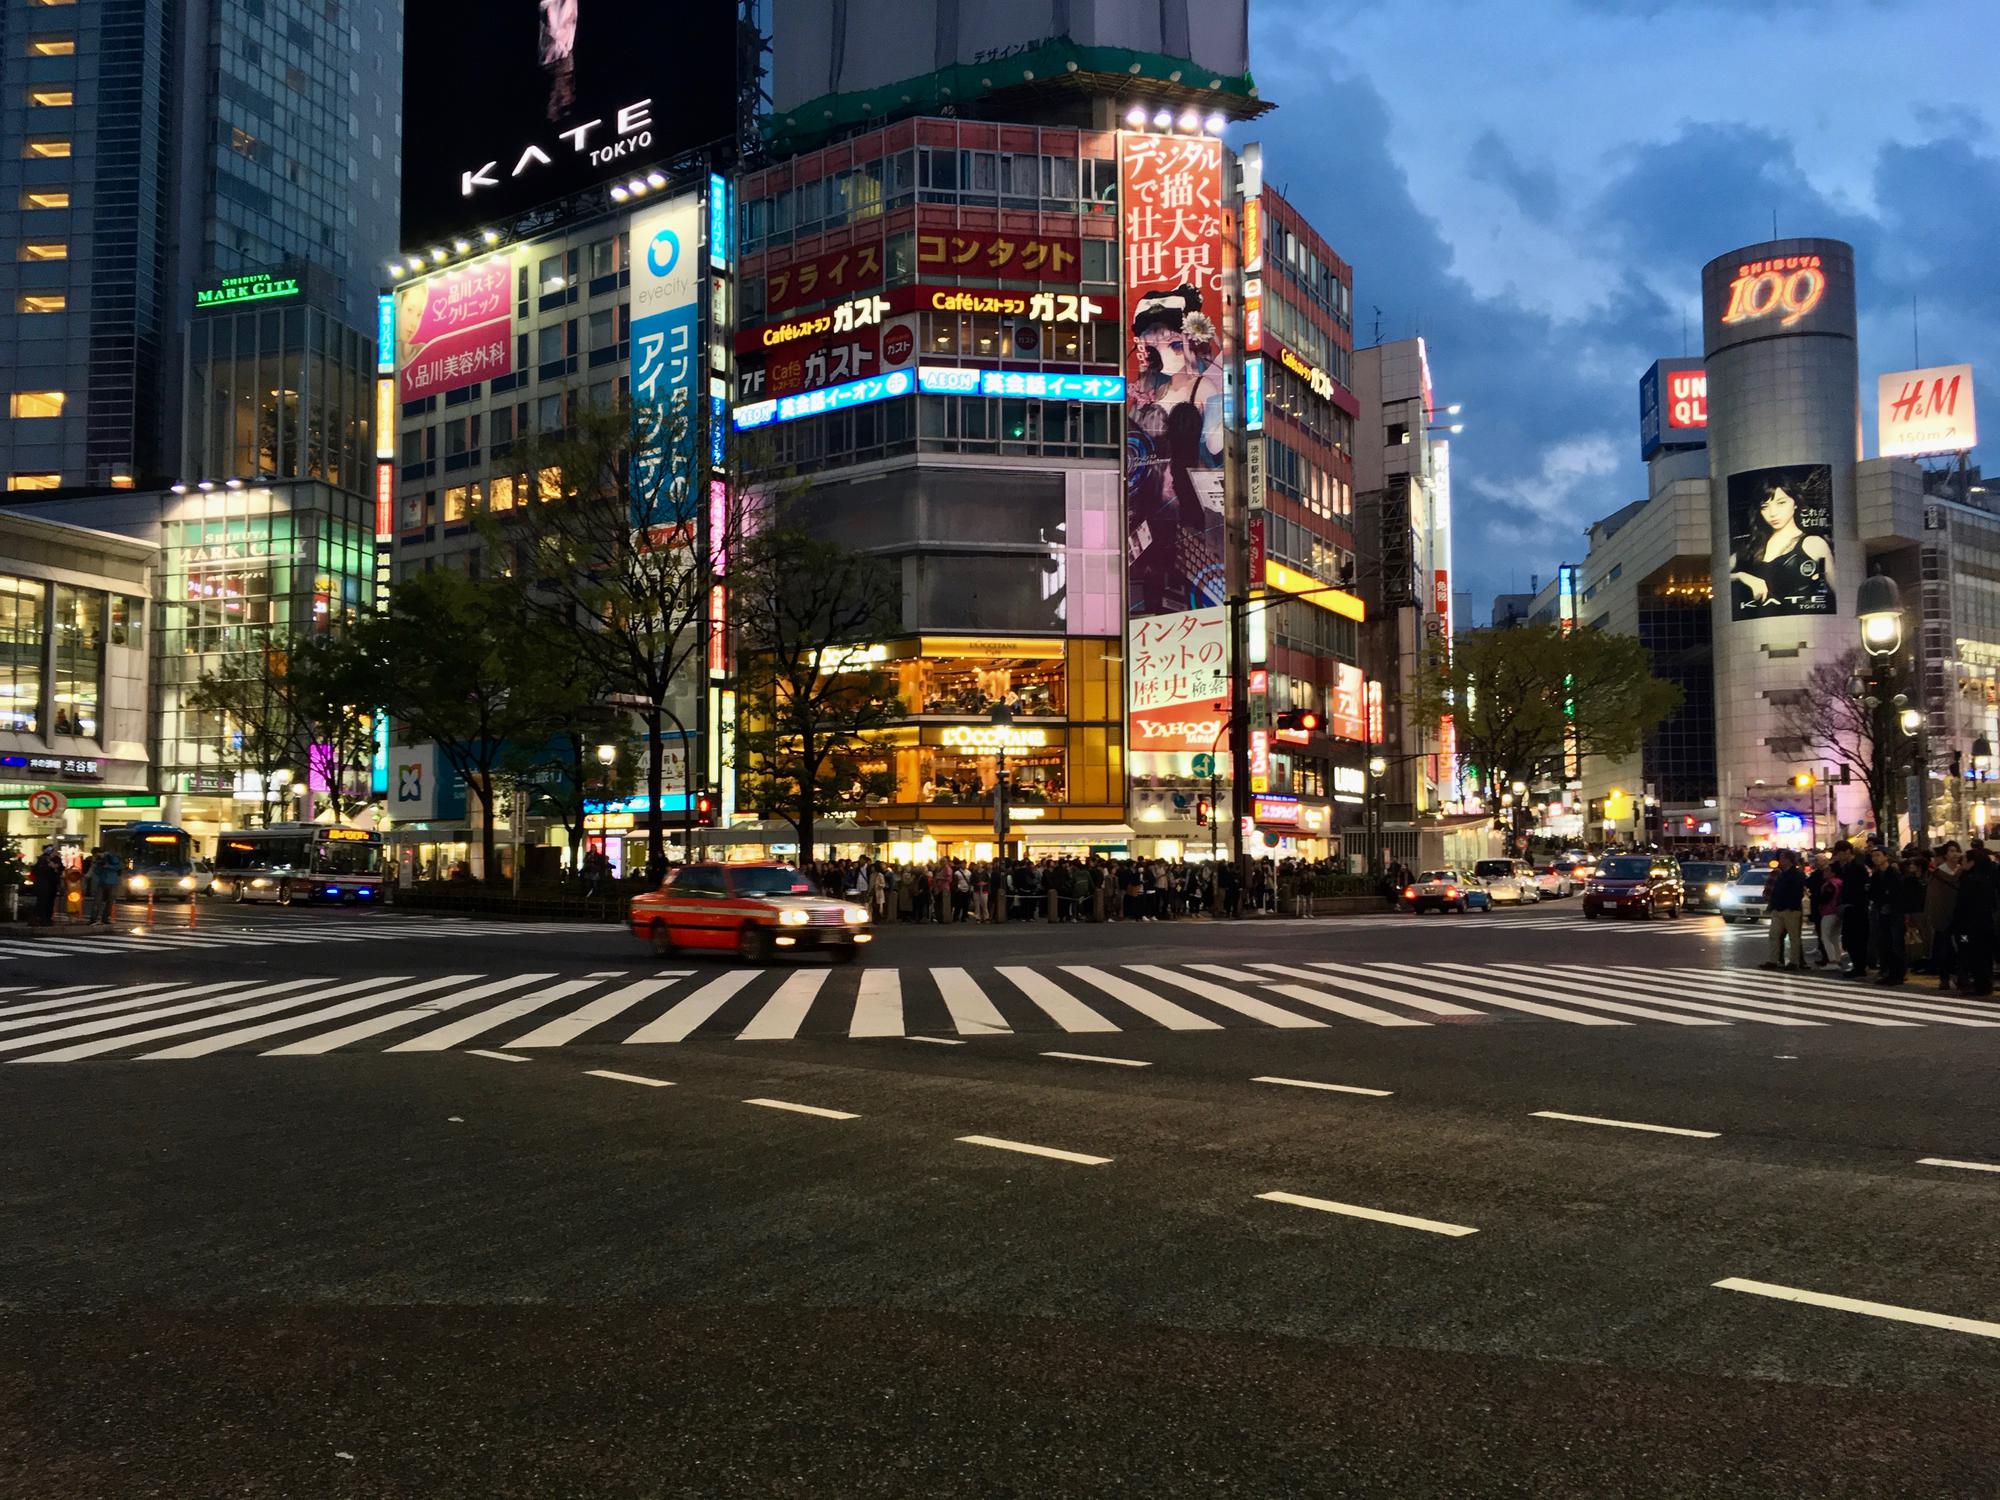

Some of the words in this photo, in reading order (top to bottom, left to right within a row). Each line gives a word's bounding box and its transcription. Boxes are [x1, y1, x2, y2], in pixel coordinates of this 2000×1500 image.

[462, 99, 651, 195] KATE
[590, 131, 651, 166] TOKYO
[1125, 137, 1221, 180] デジタル
[1127, 206, 1220, 246] 壮大な
[919, 236, 1075, 271] コンタクト
[1125, 241, 1222, 291] 世界。
[1739, 256, 1821, 277] SHIBUYA
[222, 274, 271, 287] SHIBUYA
[448, 271, 506, 304] 品川スキン
[638, 277, 688, 305] eyecity
[769, 247, 879, 302] プライス
[198, 287, 249, 303] MARK
[253, 280, 296, 295] CITY
[1029, 293, 1103, 323] ガスト
[1722, 268, 1825, 325] 109
[448, 294, 500, 325] クリニック
[833, 295, 891, 334] ガスト
[415, 341, 505, 388] 品川美容外科
[772, 360, 801, 381] Café
[804, 343, 873, 389] ガスト
[926, 371, 973, 389] AEON
[741, 370, 766, 394] 7F
[984, 374, 1121, 397] 英会話イーオン
[1891, 375, 1961, 423] H&M
[1250, 445, 1259, 503] 渋谷駅前ビル
[250, 540, 306, 557] CY
[1740, 595, 1826, 610] KATE
[1132, 615, 1223, 647] インター
[1133, 641, 1223, 676] ネットの
[1133, 673, 1188, 706] 歴史
[1136, 720, 1221, 738] YAHOO!
[64, 760, 98, 773] 渋谷駅
